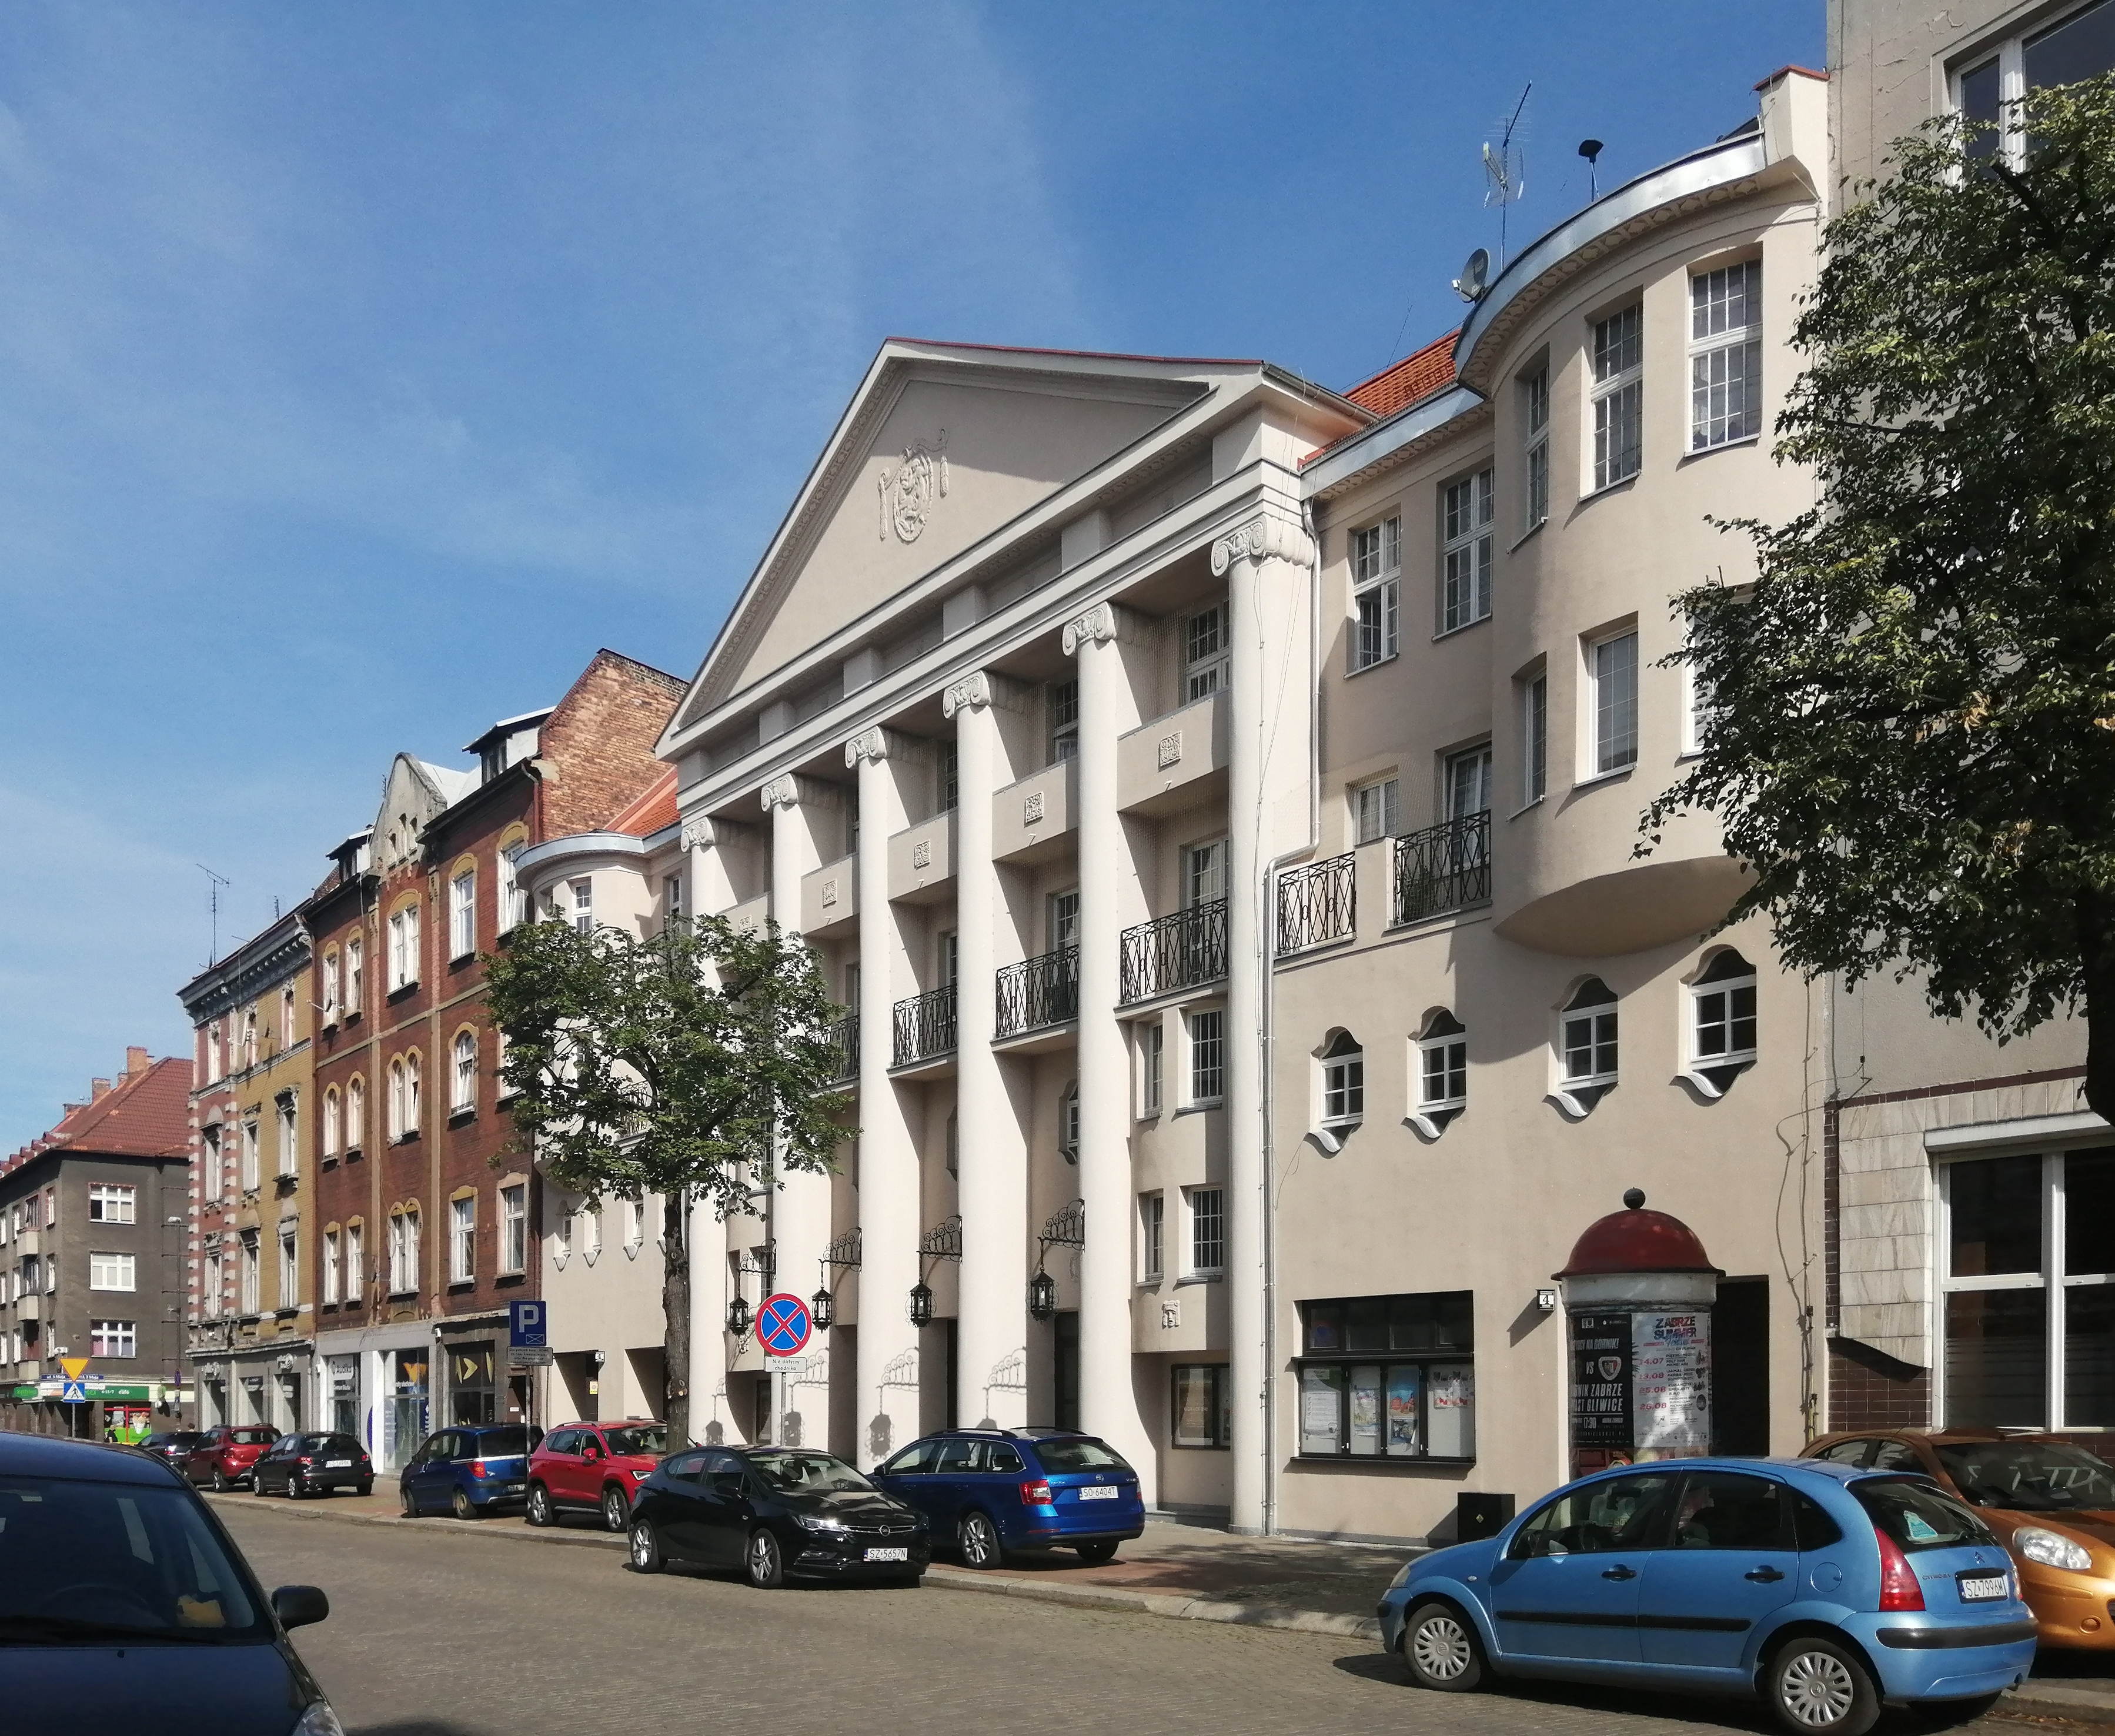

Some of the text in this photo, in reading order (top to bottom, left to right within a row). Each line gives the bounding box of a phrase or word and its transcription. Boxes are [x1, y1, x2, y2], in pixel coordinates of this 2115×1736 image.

[1543, 1294, 1549, 1304] 4
[519, 1304, 539, 1333] P
[1655, 1317, 1696, 1328] ZABRZE
[1586, 1361, 1594, 1374] VS
[1591, 1383, 1623, 1397] ZABRZE
[1587, 1398, 1623, 1412] GLIWICE
[1084, 1487, 1115, 1497] SO 6404T
[870, 1549, 906, 1558] SZ 5657N
[1966, 1580, 1979, 1597] SZ
